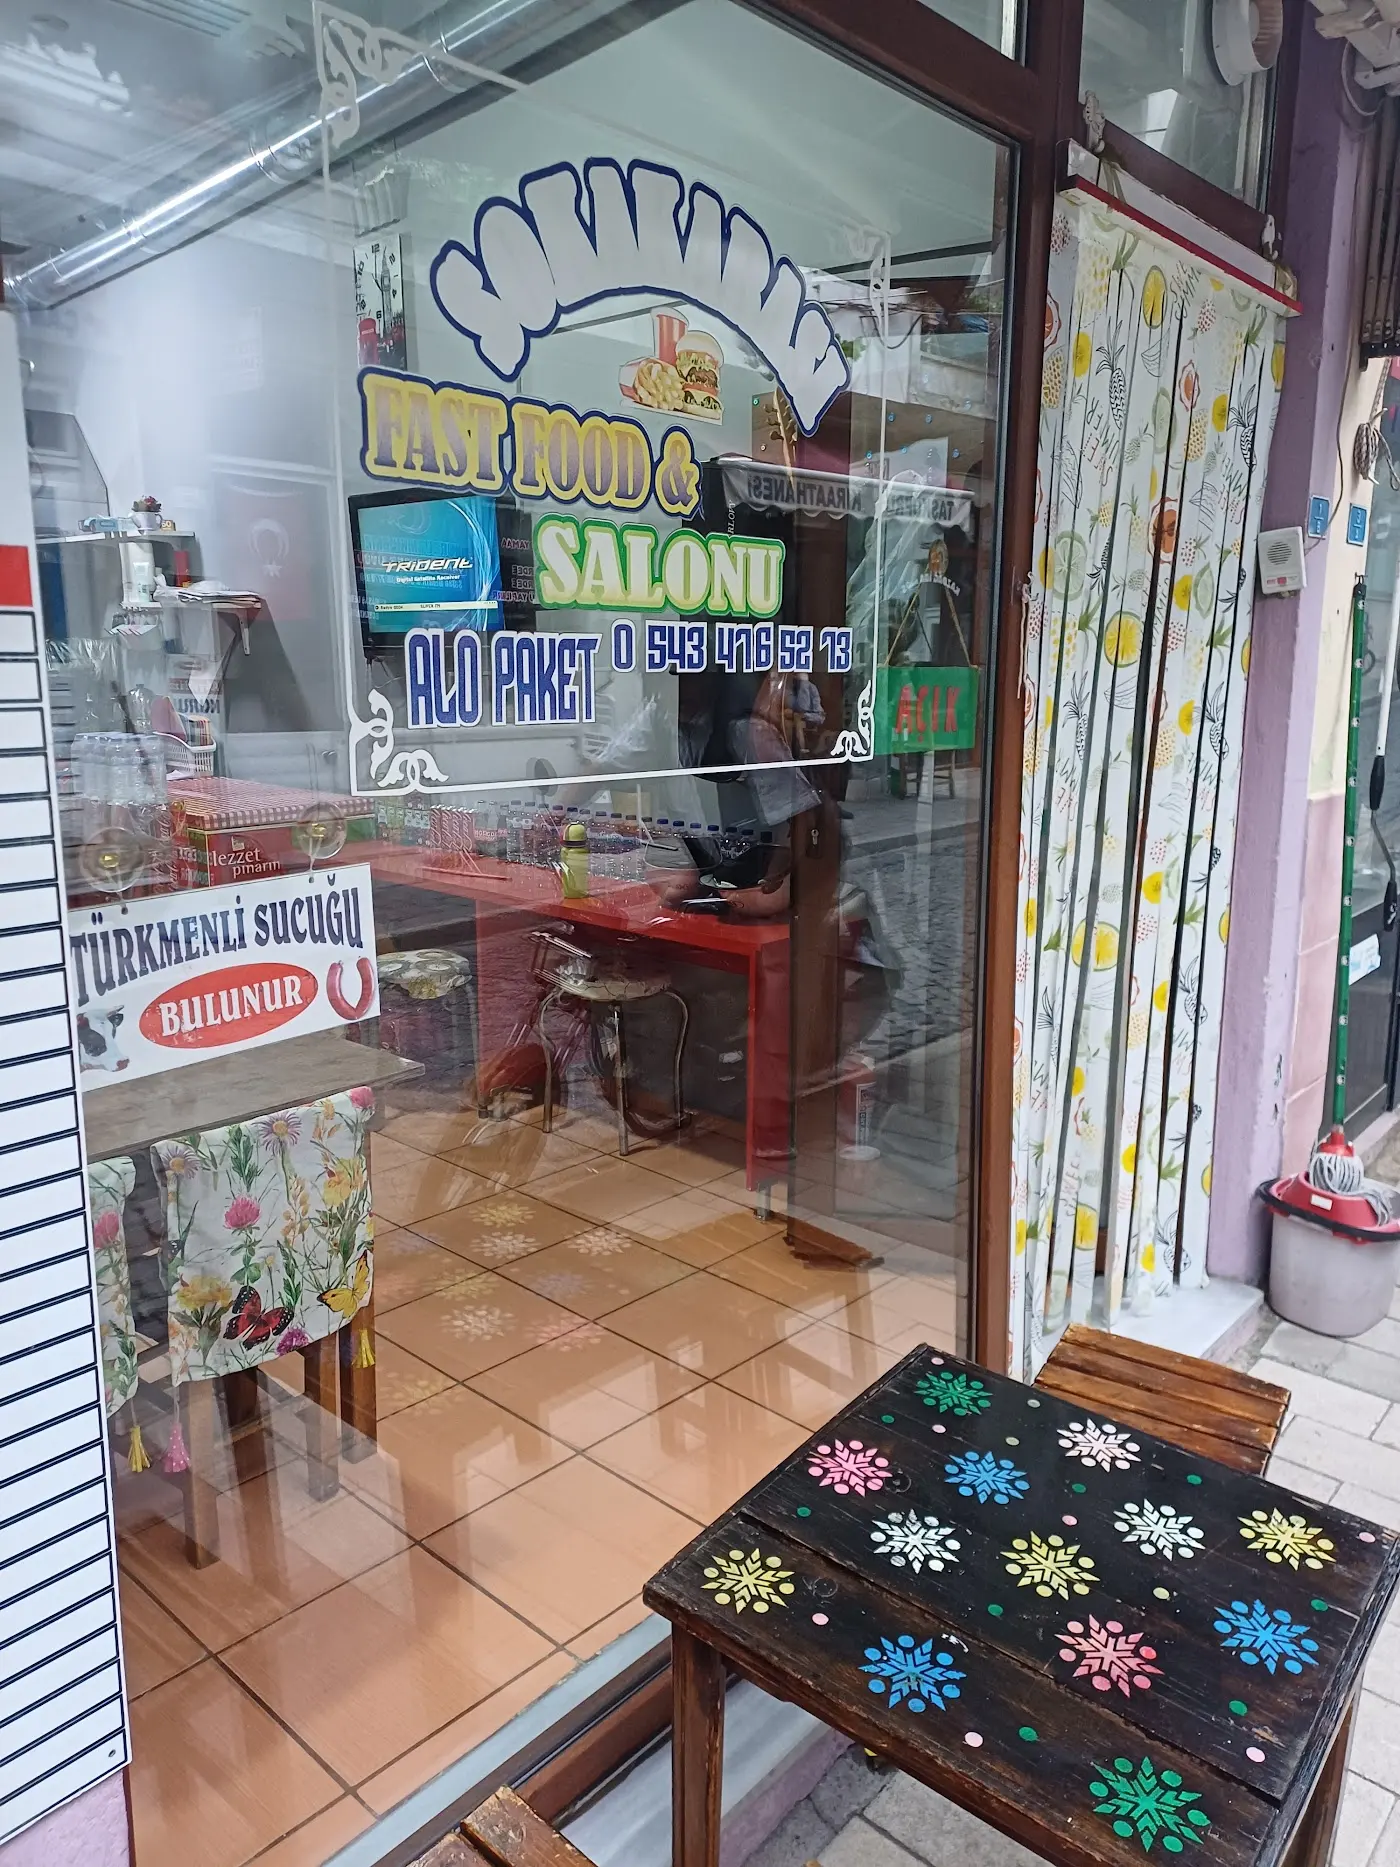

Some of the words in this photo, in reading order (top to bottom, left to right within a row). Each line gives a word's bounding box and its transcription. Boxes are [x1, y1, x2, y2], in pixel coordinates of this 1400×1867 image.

[364, 376, 506, 489] FAST
[512, 403, 652, 508] FOOD
[656, 432, 699, 515] &
[538, 523, 784, 616] SALONU
[407, 629, 481, 728] ALO
[493, 631, 602, 725] PAKET
[612, 618, 636, 672] 0
[646, 620, 707, 673] 543
[778, 625, 814, 673] 52
[895, 685, 961, 743] AÇIK
[212, 847, 261, 867] lezzet
[69, 895, 248, 1008] TÜRKMENLİ
[254, 873, 363, 949] SUCUĞU
[158, 975, 303, 1038] BULUNUR
